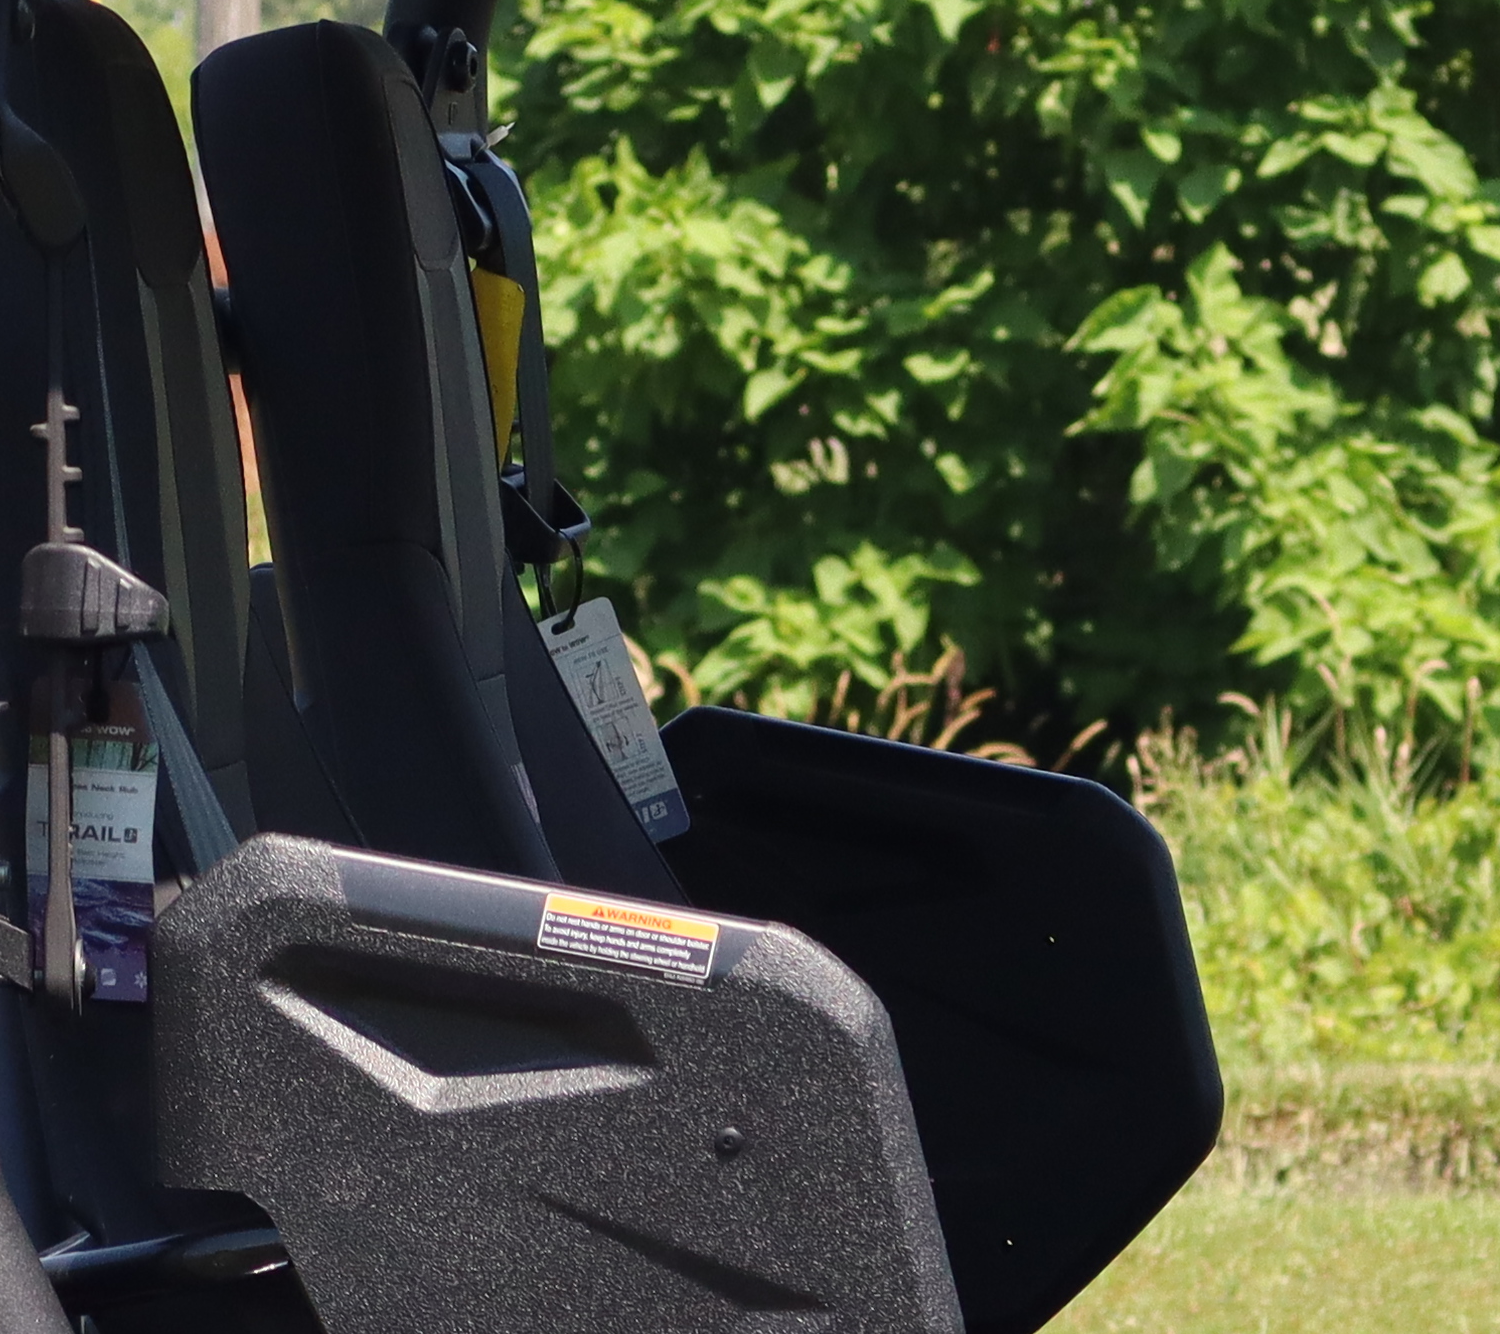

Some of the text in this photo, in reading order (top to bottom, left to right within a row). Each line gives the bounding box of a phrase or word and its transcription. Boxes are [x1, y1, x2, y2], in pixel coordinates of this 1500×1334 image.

[547, 913, 555, 922] Do
[581, 919, 600, 929] hands
[609, 926, 625, 934] arms
[636, 930, 650, 939] door
[659, 935, 686, 946] shoulder
[607, 908, 672, 930] WARNING
[545, 924, 551, 932] To
[552, 927, 570, 936] avoid
[590, 932, 605, 943] keep
[606, 936, 626, 946] hands
[627, 940, 639, 949] and
[640, 943, 655, 952] arms
[657, 946, 691, 960] completely
[559, 939, 568, 947] the
[590, 944, 597, 954] by
[598, 946, 619, 958] holding
[620, 950, 629, 959] the
